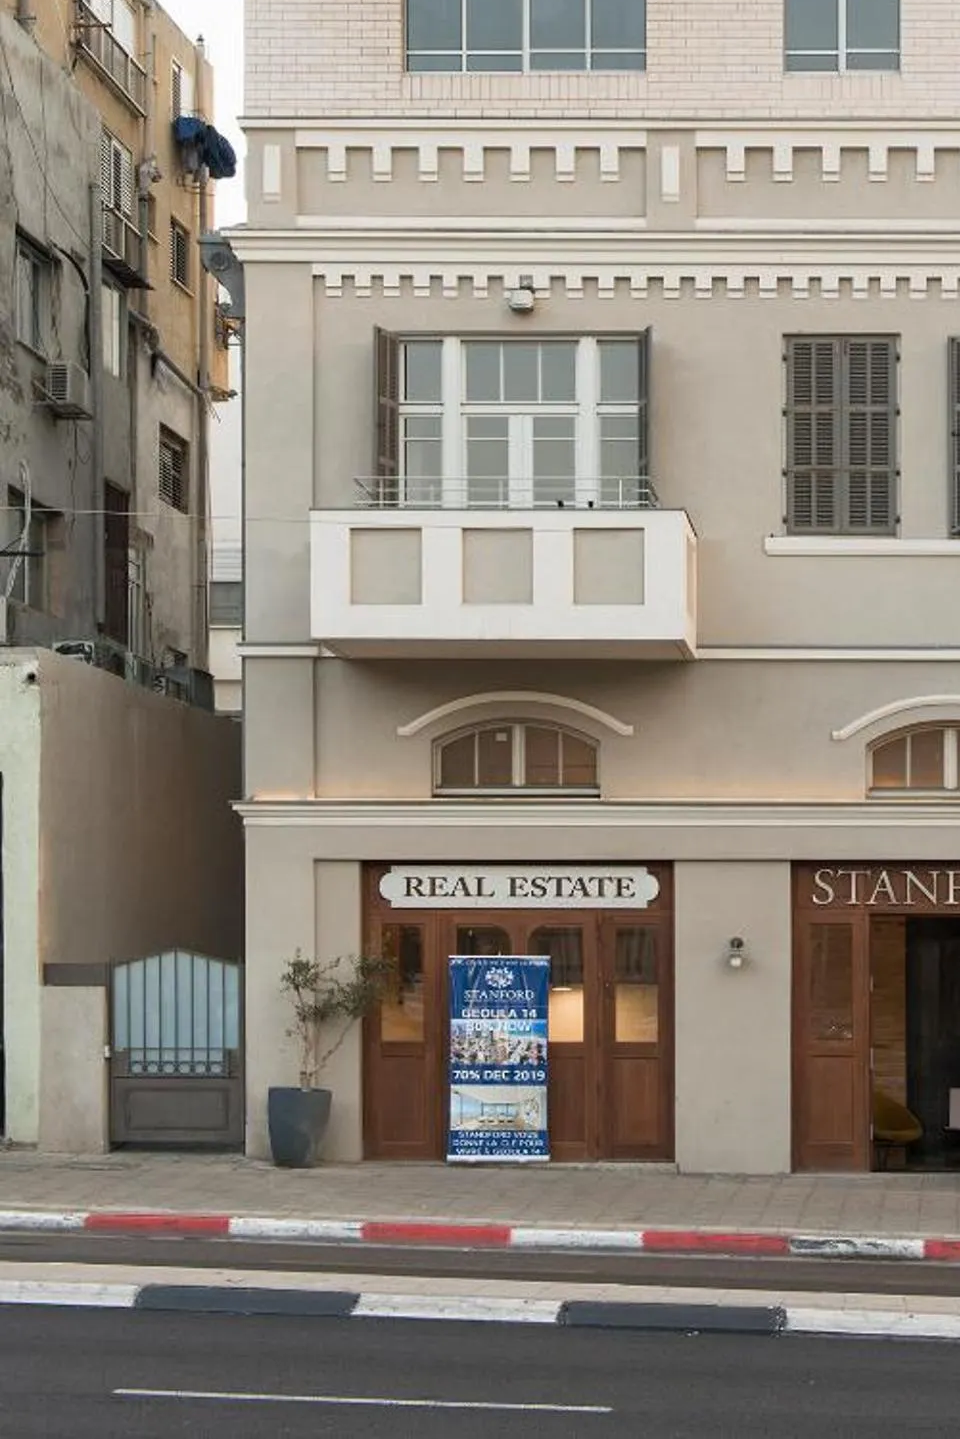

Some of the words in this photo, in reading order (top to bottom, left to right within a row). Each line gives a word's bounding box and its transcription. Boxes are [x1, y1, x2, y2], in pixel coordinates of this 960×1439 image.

[403, 876, 495, 898] REAL
[506, 876, 636, 898] ESTATE
[464, 990, 534, 999] STANFORD
[453, 1070, 480, 1079] 70%
[483, 1070, 511, 1080] DEC
[513, 1070, 546, 1081] 2019
